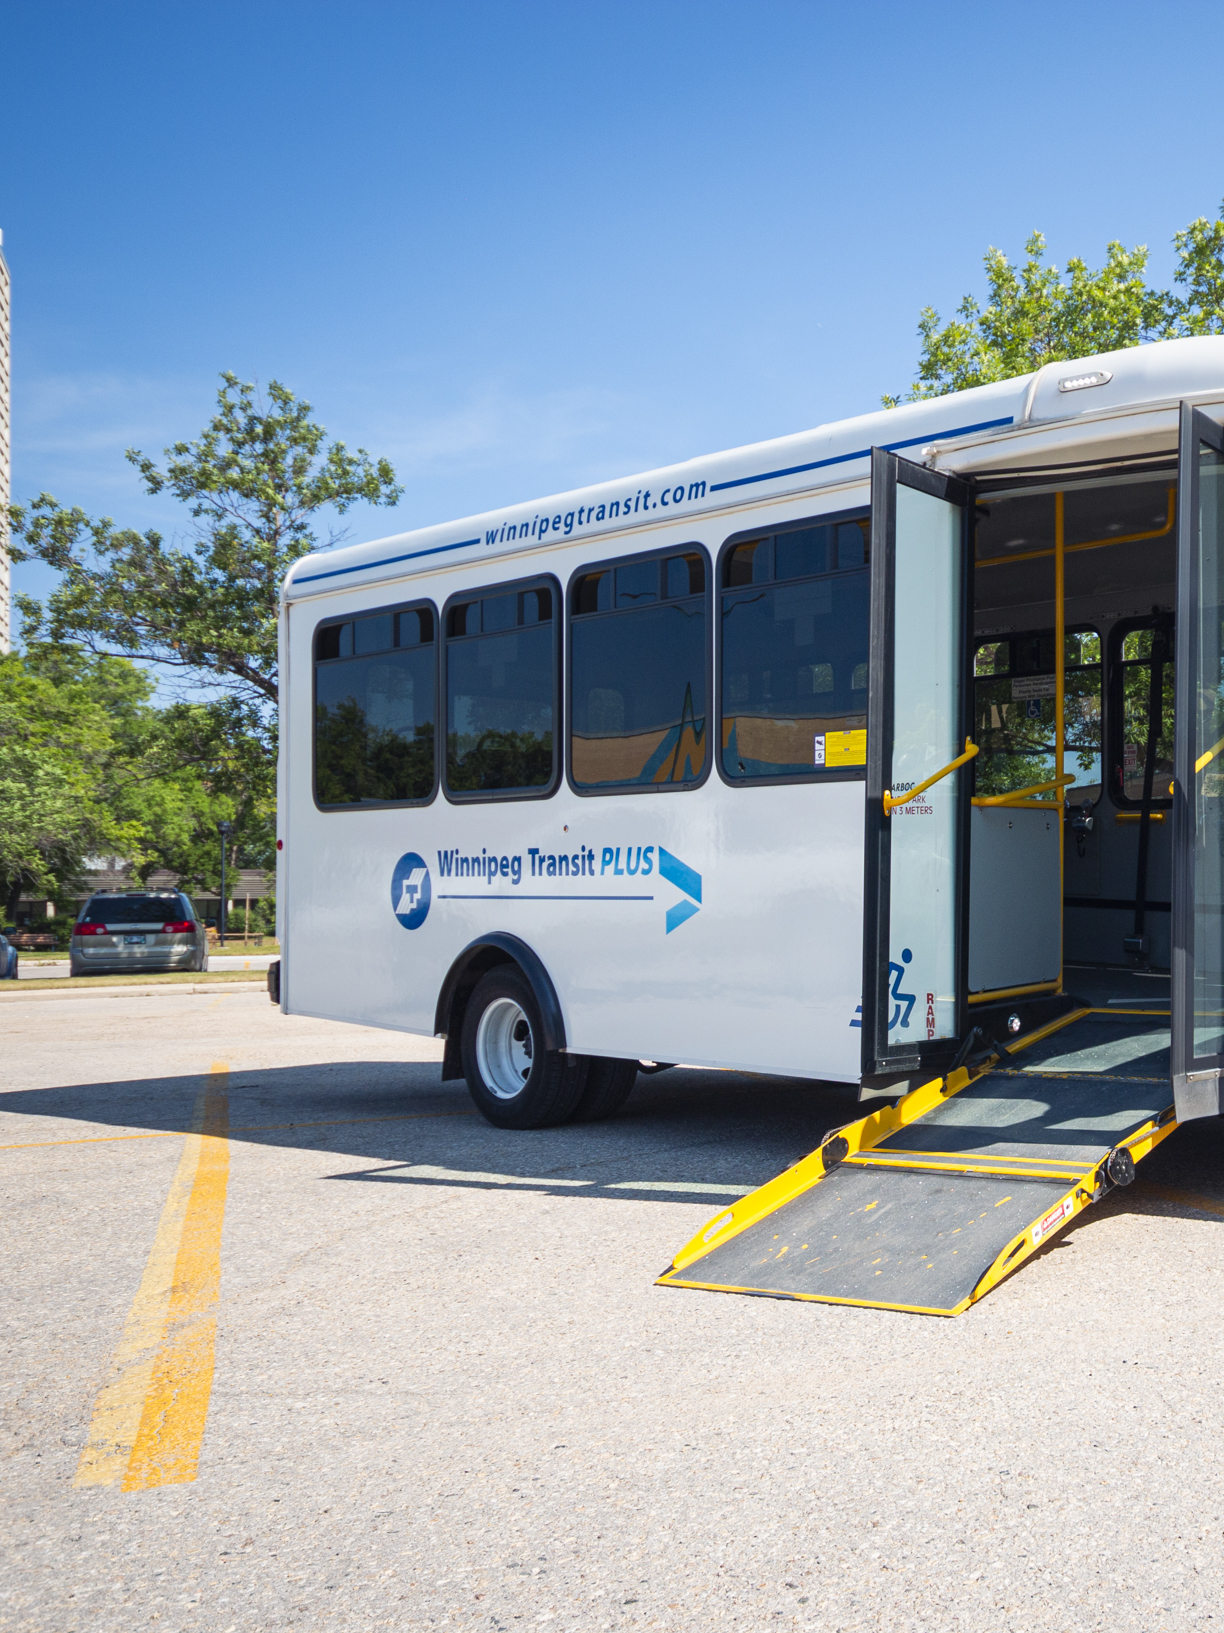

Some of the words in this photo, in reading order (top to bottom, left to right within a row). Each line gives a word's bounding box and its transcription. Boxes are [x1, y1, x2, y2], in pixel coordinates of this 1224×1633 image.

[485, 480, 707, 545] winnipegtransit.com
[1125, 758, 1135, 766] EXIT
[899, 806, 903, 815] 3
[905, 806, 933, 815] METERS
[908, 795, 926, 803] ARK
[437, 848, 522, 886] Winnipeg
[528, 845, 595, 876] Transit
[600, 846, 655, 876] PLUS
[926, 993, 935, 1040] RAMP
